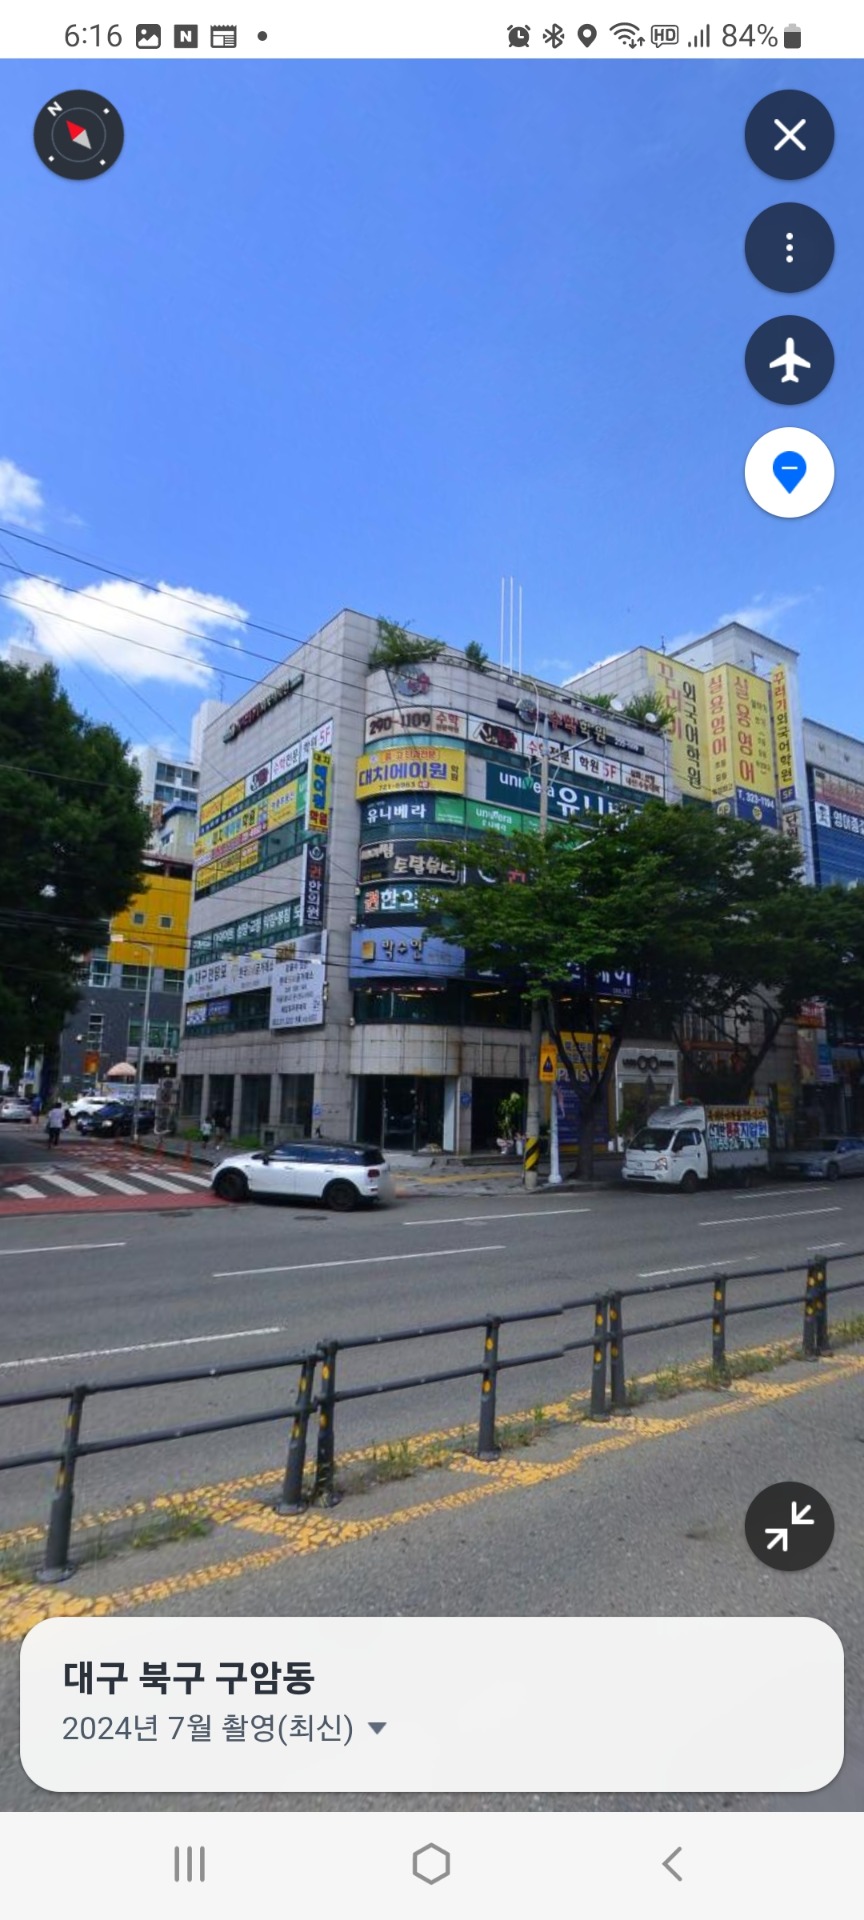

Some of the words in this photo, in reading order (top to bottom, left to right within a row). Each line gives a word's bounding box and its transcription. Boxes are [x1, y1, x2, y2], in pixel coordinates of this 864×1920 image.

[435, 712, 459, 726] 수학
[708, 674, 727, 756] 실용영어
[682, 680, 701, 790] 외국어학원
[734, 675, 756, 785] 실용영어
[358, 761, 447, 787] 대치에이원
[579, 755, 599, 774] 학원
[602, 762, 617, 779] 5F
[366, 803, 427, 824] 유니베라
